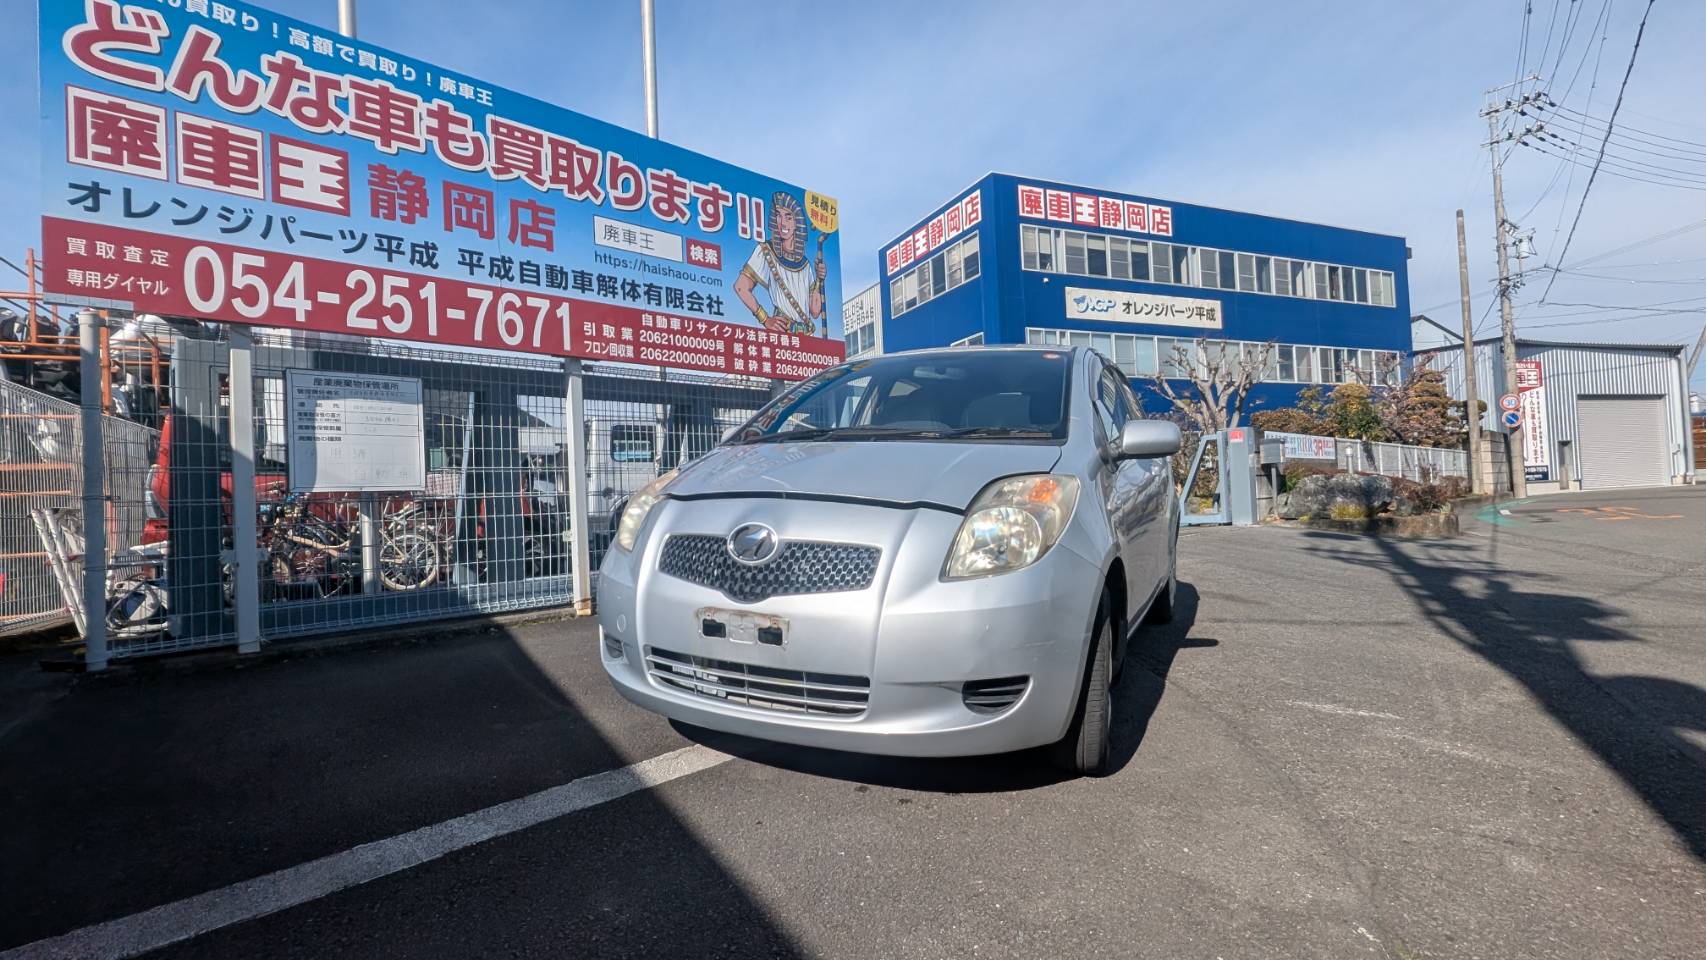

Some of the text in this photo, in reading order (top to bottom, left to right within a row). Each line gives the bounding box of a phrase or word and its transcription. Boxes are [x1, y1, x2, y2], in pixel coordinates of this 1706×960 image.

[67, 88, 556, 253] 廃車王 静岡店
[810, 194, 837, 215] 見積り
[66, 181, 725, 316] オレンジパーツ平成 平成自動車解体有限会社
[66, 236, 170, 268] 買取査定
[603, 224, 718, 265] 廃車王 検索
[66, 269, 169, 297] 専用ダイヤル
[594, 250, 723, 287] https://haishaou.com
[184, 246, 572, 351] 054-251-7671
[1122, 300, 1217, 322] オレンジパーツ平成
[639, 330, 725, 353] 20621000009号
[641, 314, 801, 347] 自動車リサイクル法許可番号
[640, 347, 726, 369] 20622000009号
